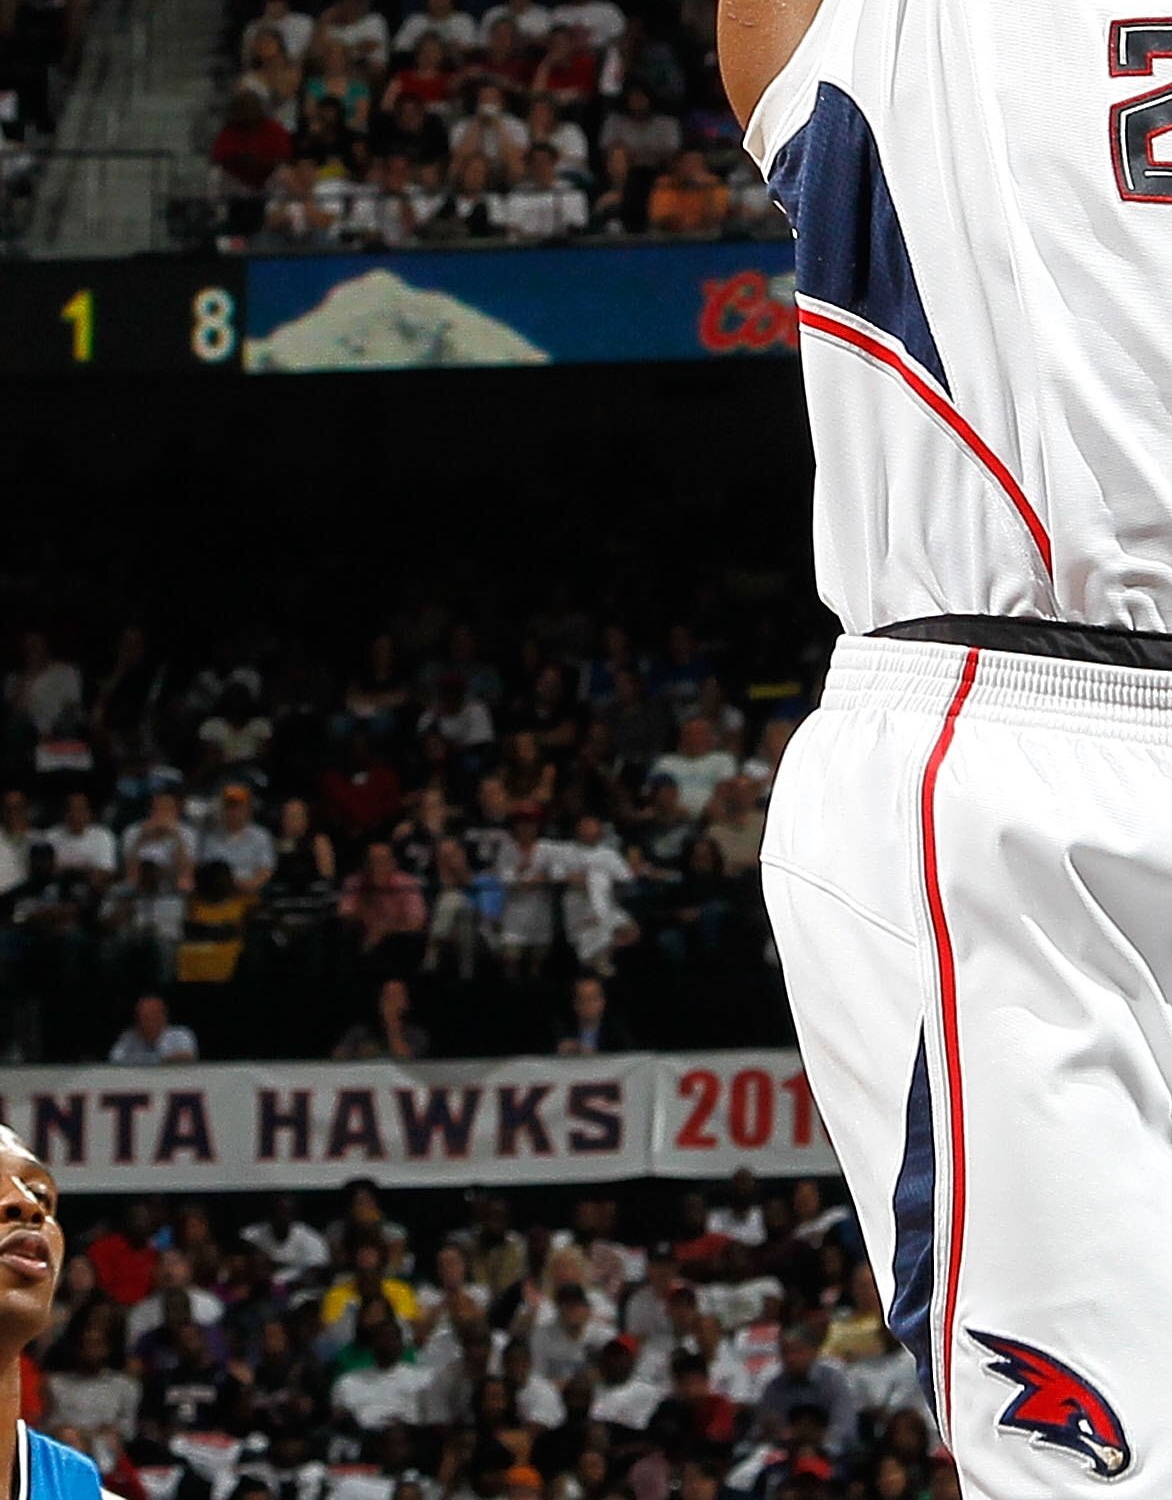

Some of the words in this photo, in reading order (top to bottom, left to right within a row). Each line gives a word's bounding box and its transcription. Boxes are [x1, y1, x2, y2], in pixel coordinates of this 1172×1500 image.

[60, 286, 96, 364] 1
[189, 284, 238, 364] 8
[255, 1079, 624, 1161] HAWKS
